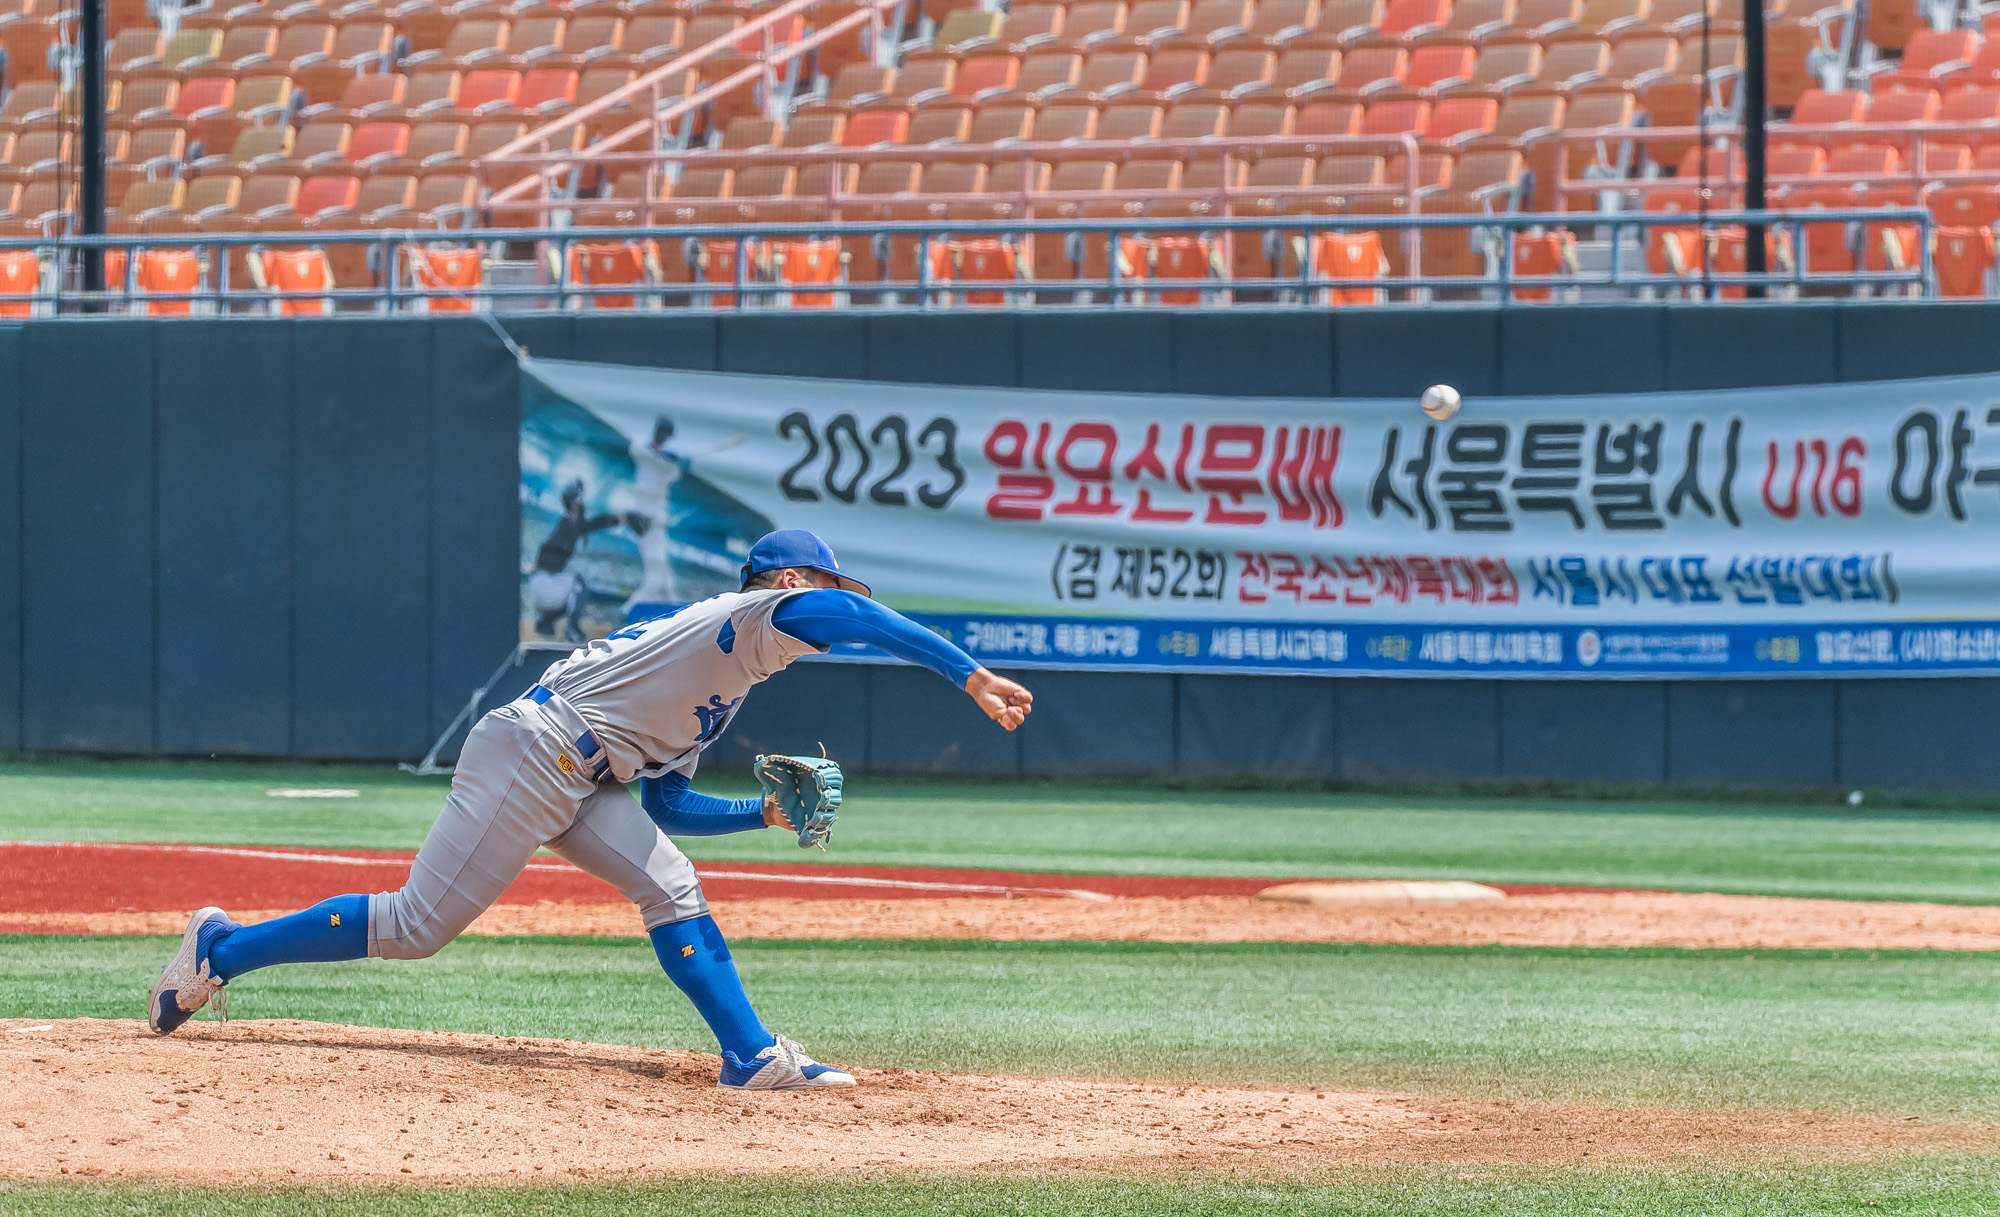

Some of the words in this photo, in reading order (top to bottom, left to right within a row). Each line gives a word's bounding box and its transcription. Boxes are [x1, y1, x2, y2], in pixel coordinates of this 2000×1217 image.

[779, 411, 965, 509] 2023
[983, 420, 1345, 529] 일요신문배
[1370, 419, 1741, 531] 서울특별시
[1762, 435, 1867, 520] U16
[1051, 543, 1101, 600] (겸
[1112, 547, 1227, 602] 제52회)
[1235, 551, 1520, 606] 전국소년체육대회
[1527, 555, 1637, 605] 서울시
